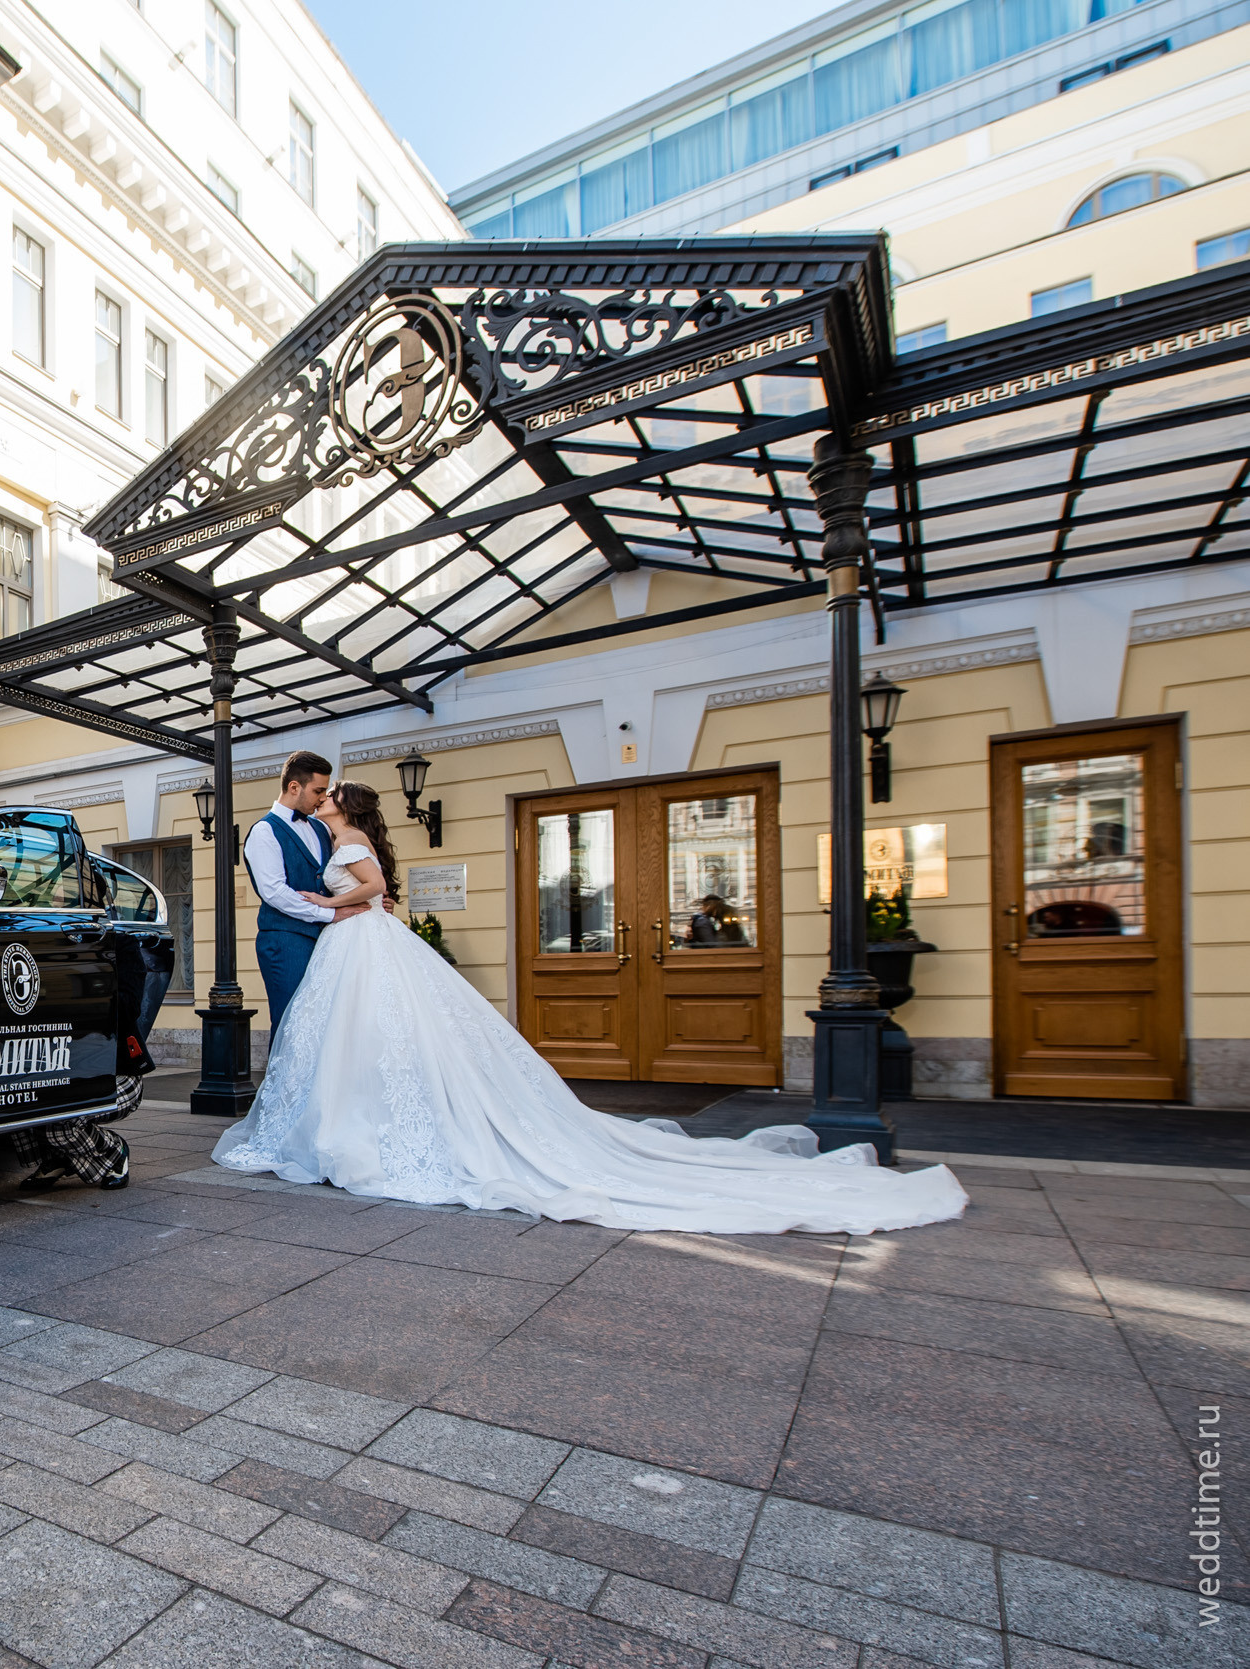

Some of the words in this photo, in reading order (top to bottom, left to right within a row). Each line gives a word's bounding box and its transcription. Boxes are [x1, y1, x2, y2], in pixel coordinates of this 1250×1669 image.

[28, 1022, 73, 1032] ГОСТИНИЦА
[10, 1081, 32, 1091] STATE
[32, 1077, 71, 1089] HERMITAGE
